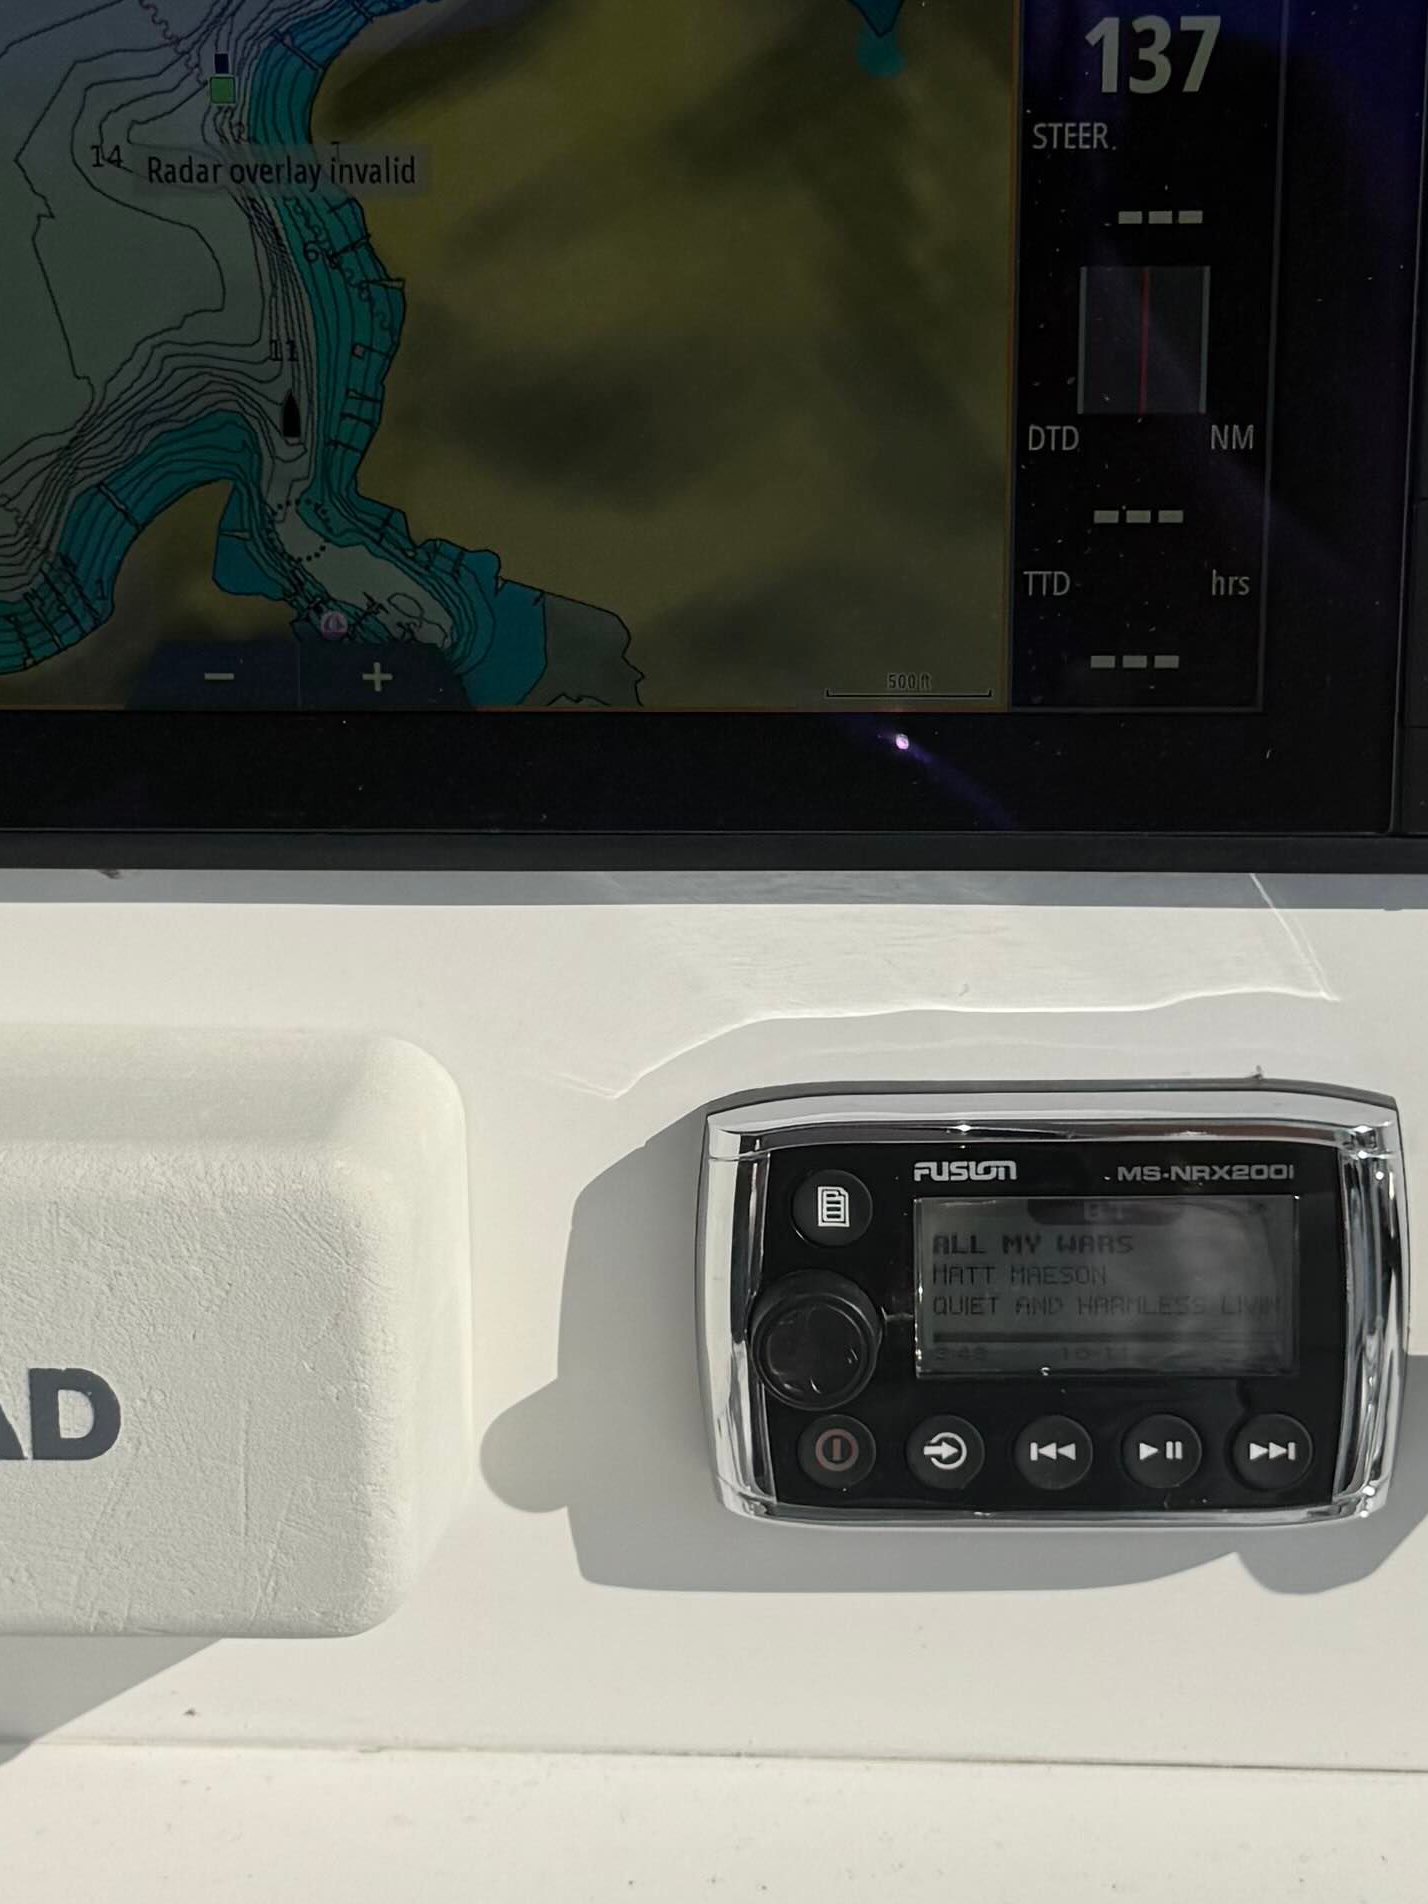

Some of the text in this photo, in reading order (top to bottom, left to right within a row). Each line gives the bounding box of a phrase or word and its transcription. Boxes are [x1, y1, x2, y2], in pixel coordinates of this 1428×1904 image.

[1083, 14, 1223, 96] 137
[1031, 121, 1110, 151] STEER
[89, 145, 124, 170] 14
[147, 154, 416, 193] Radar overlay invalid
[1027, 424, 1256, 453] DTD NM
[1022, 570, 1252, 598] TTD hrs
[889, 674, 916, 689] 500
[913, 1159, 1019, 1182] FUSION
[933, 1235, 1134, 1255] ALL MY WARS
[933, 1264, 1107, 1287] MATT MAESON
[933, 1295, 998, 1316] QUIET
[1016, 1296, 1065, 1316] AND
